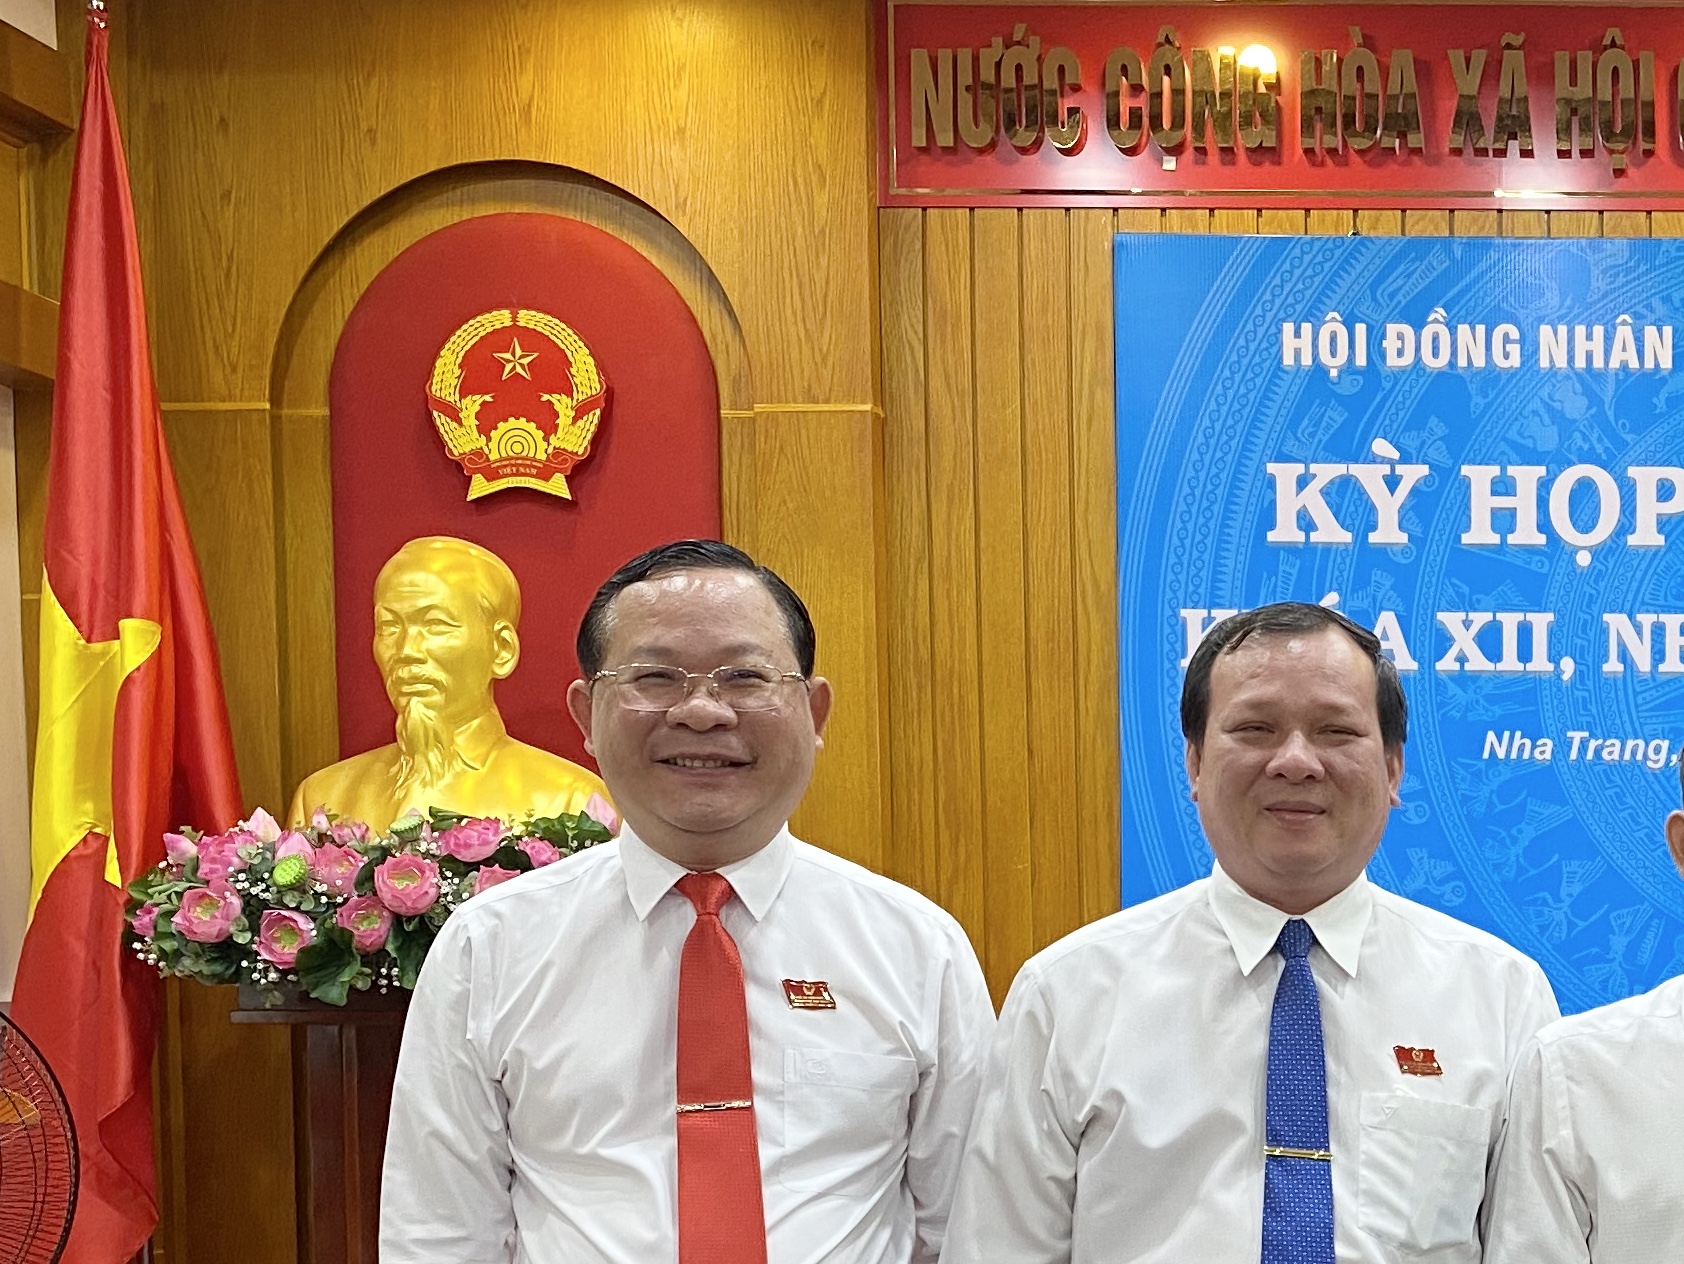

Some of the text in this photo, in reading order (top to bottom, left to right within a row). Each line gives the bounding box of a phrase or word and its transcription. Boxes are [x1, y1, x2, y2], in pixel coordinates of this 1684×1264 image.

[909, 23, 1080, 152] NƯỚC
[1103, 25, 1281, 171] CỘNG
[1300, 26, 1424, 153] HÒA
[1448, 31, 1531, 157] XÃ
[1554, 27, 1656, 171] HỘI
[1283, 312, 1367, 377] HỘI
[1382, 307, 1521, 370] ĐỒNG
[1539, 314, 1673, 371] NHÂN
[1266, 438, 1429, 543] KỲ
[1180, 592, 1418, 670] KA
[1436, 612, 1574, 682] XII,
[1482, 731, 1553, 760] Nha
[1566, 731, 1680, 769] Trang,
